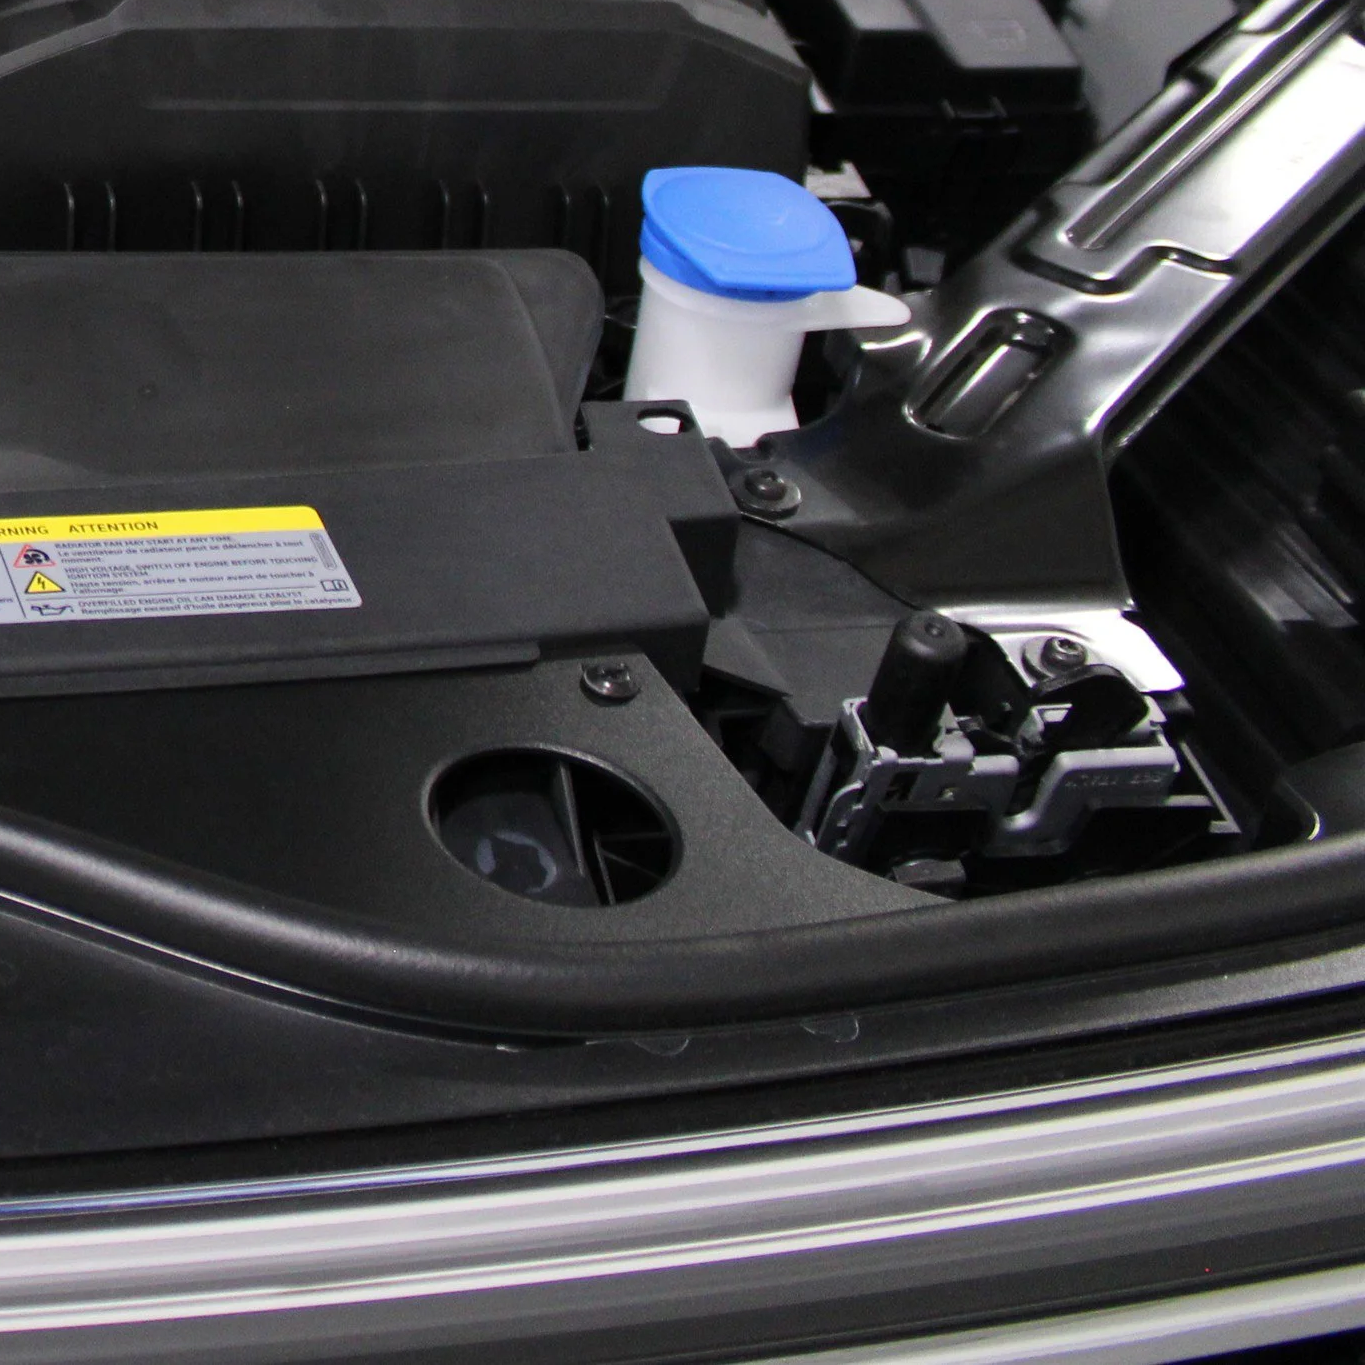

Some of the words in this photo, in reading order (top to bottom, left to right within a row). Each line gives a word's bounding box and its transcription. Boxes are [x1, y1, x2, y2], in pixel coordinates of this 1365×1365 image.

[69, 521, 159, 533] ATTENTION
[72, 548, 123, 556] ventilateur
[216, 593, 256, 601] DAMAGE
